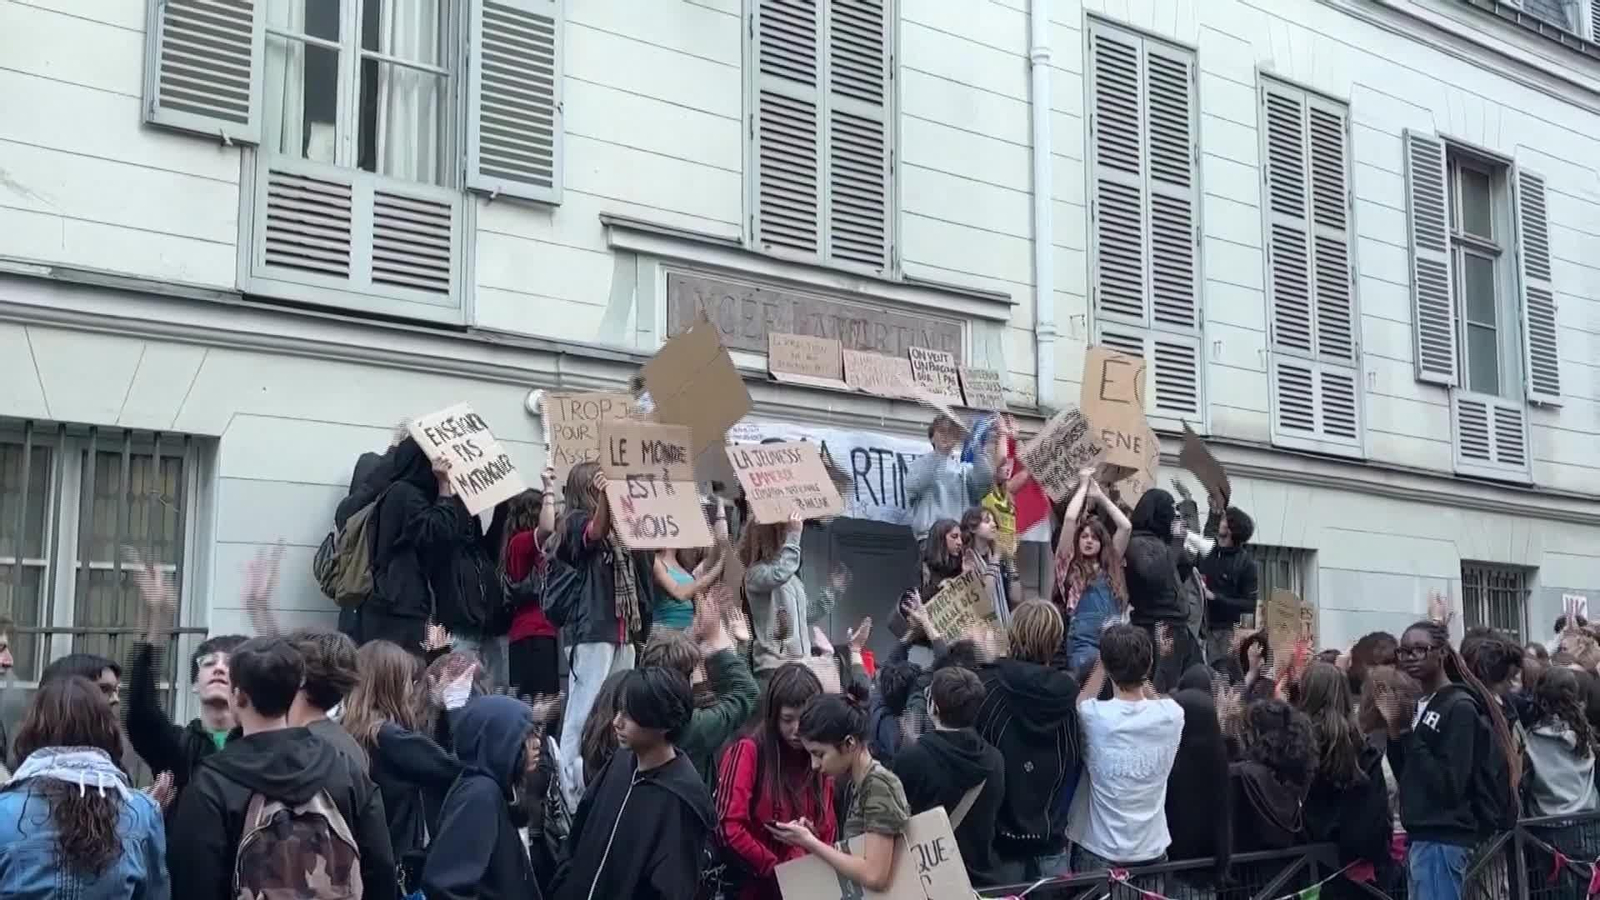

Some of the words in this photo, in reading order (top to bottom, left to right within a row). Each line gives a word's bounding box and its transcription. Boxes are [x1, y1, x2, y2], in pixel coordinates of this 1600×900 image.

[911, 348, 926, 360] ON
[553, 395, 612, 421] TROP
[553, 423, 593, 441] POUR
[452, 439, 484, 463] PAS
[609, 435, 630, 467] LE
[641, 439, 687, 466] MONDE
[732, 450, 752, 470] LA
[755, 446, 805, 467] JEUNESSE
[626, 472, 657, 499] EST
[909, 836, 950, 874] QUE
